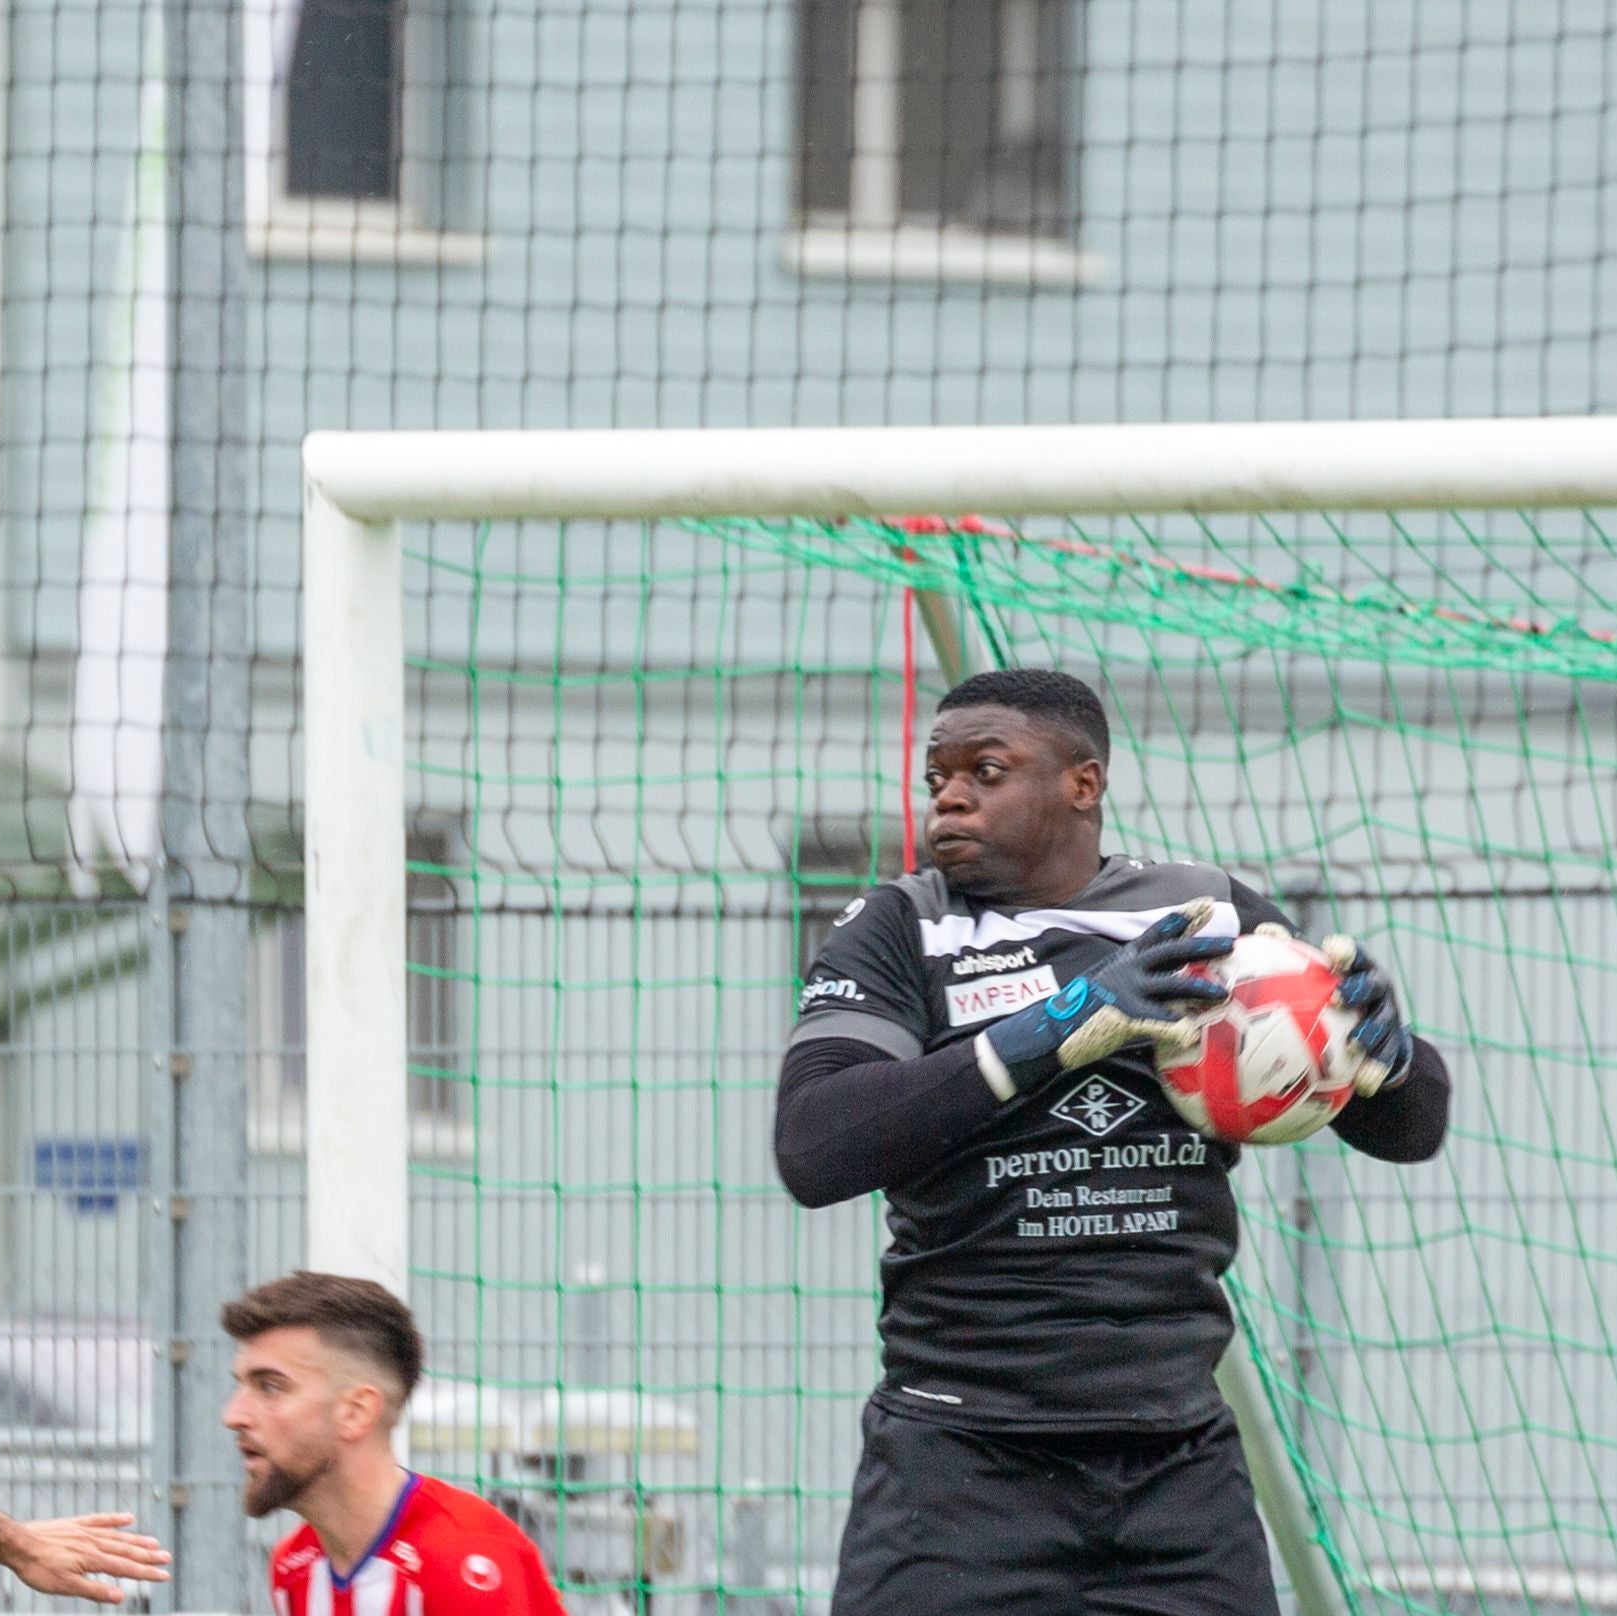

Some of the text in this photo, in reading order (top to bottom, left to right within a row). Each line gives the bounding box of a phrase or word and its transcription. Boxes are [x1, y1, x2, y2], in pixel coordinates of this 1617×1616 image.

[952, 945, 1037, 975] uhlsport
[955, 978, 1052, 1014] YAPEAL
[984, 1133, 1207, 1188] perron-nord.ch
[1026, 1185, 1173, 1209] Dein Restaurant
[1017, 1210, 1180, 1237] im HOTEL APART
